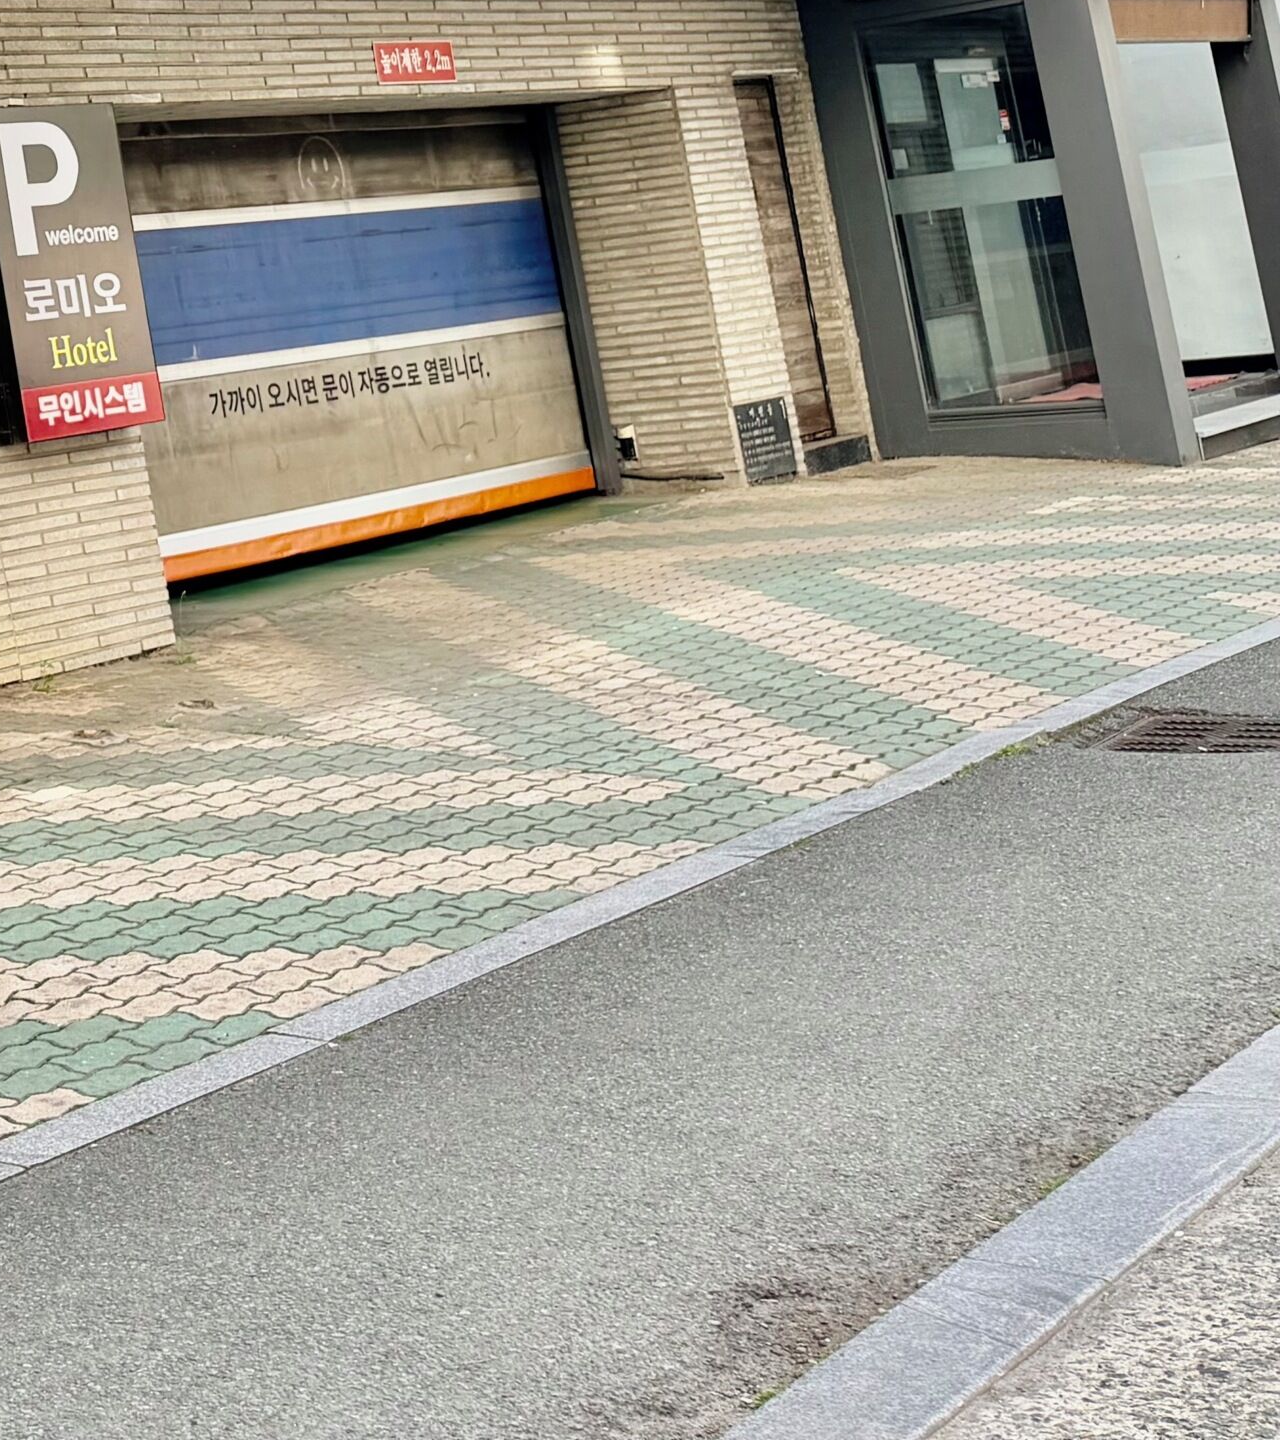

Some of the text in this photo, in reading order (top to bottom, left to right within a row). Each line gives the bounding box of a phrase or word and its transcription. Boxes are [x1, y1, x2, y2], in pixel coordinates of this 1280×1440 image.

[380, 47, 422, 74] 높이제한
[45, 224, 119, 247] welcome
[24, 272, 127, 322] 로미오
[48, 327, 118, 369] Hotel
[38, 381, 147, 427] 무인시스템
[209, 352, 490, 419] 가까이 오시면 문이 자동으로 열립니다.
